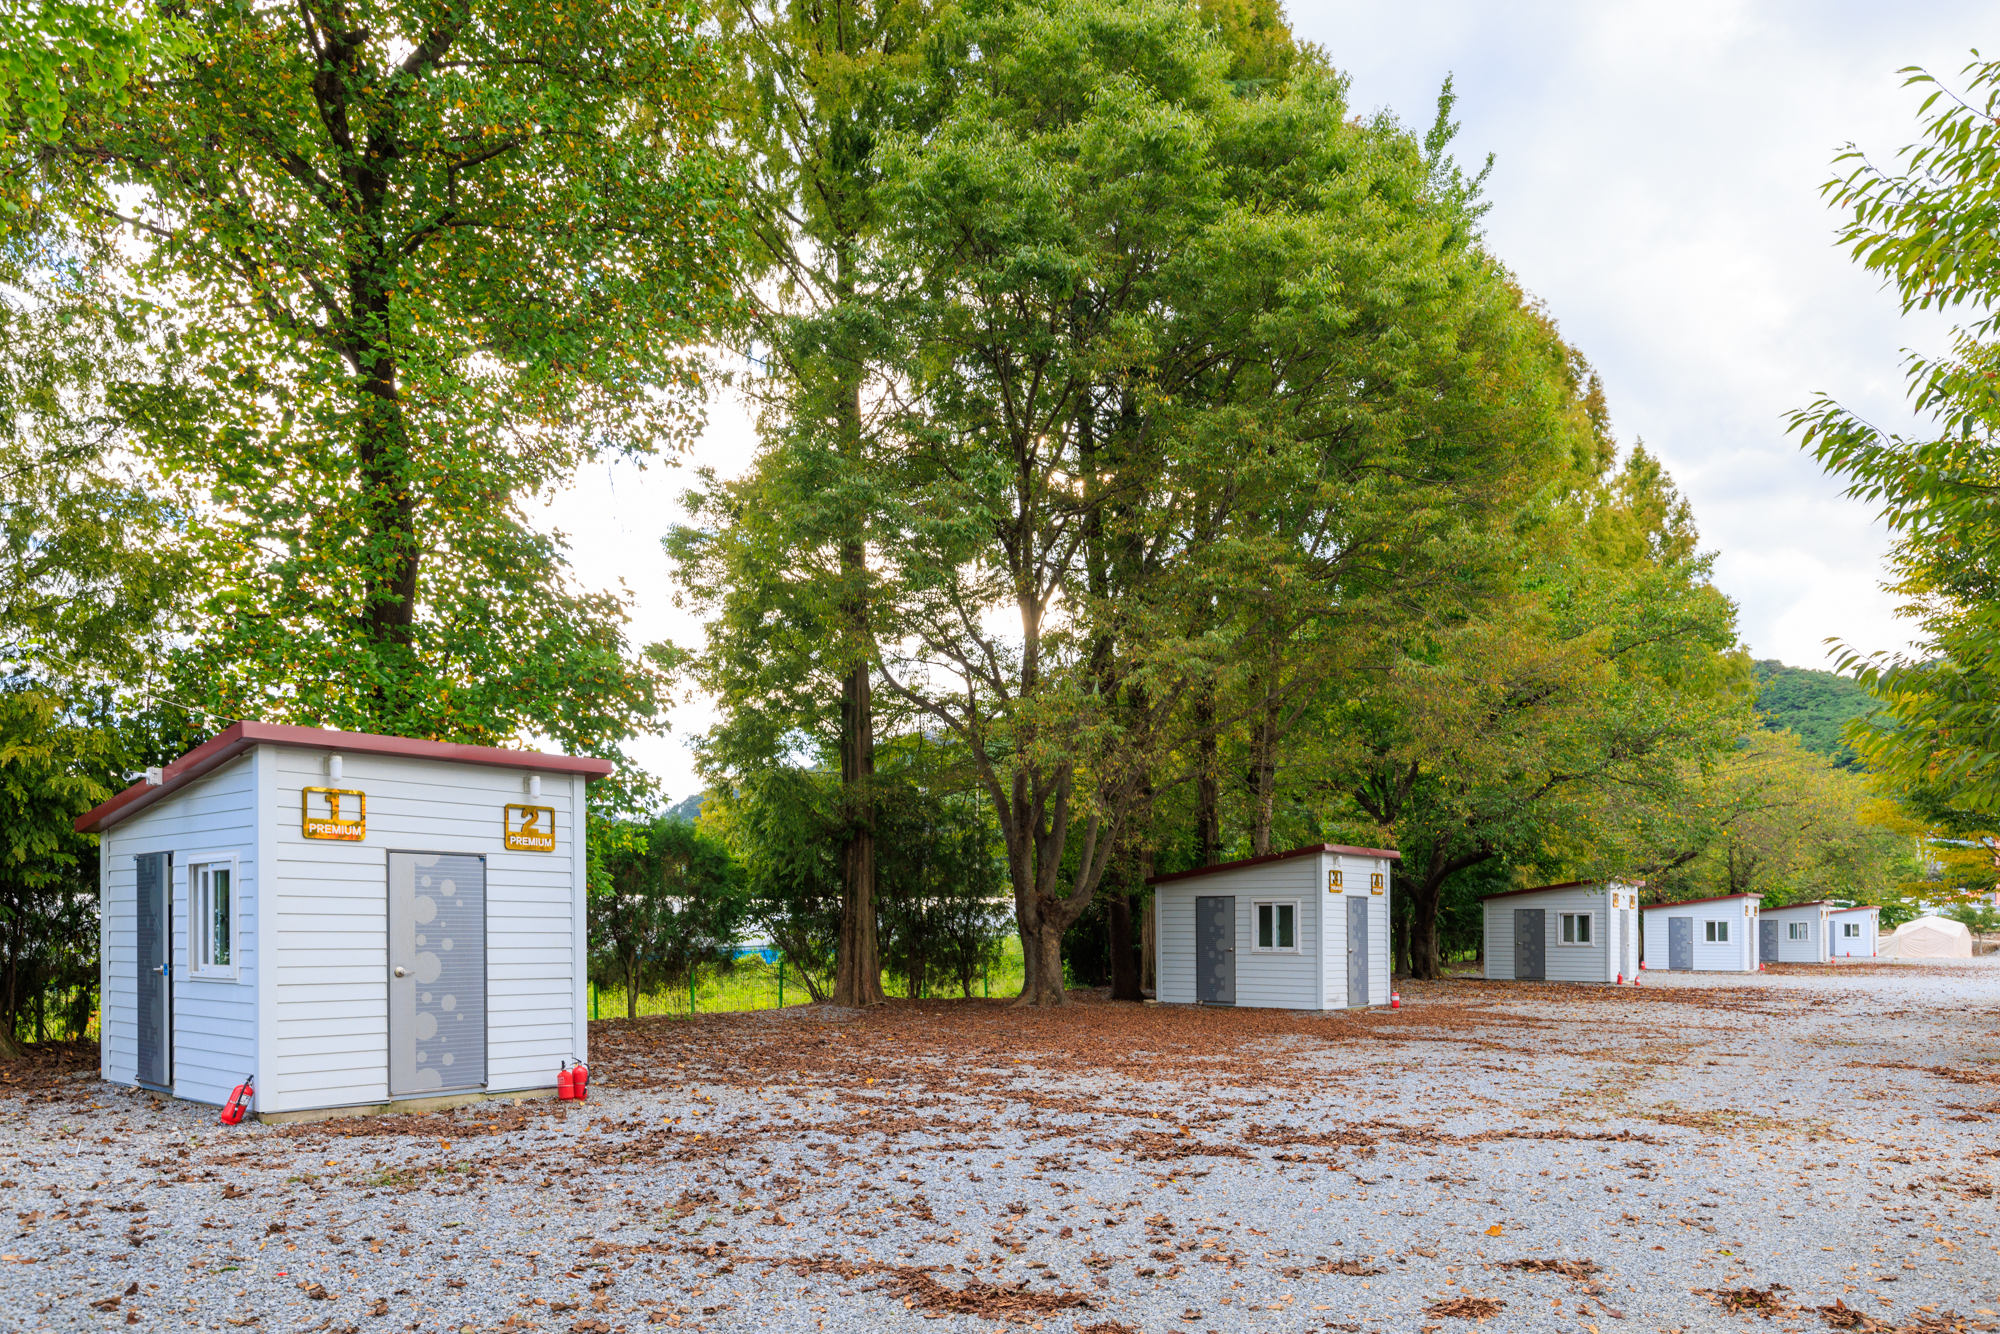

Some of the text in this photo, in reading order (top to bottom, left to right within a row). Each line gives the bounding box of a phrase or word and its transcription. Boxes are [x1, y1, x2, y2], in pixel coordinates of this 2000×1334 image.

[325, 789, 340, 821] 1
[309, 823, 362, 836] PREMIUM
[521, 807, 539, 833] 2
[510, 836, 552, 847] PREMIUM
